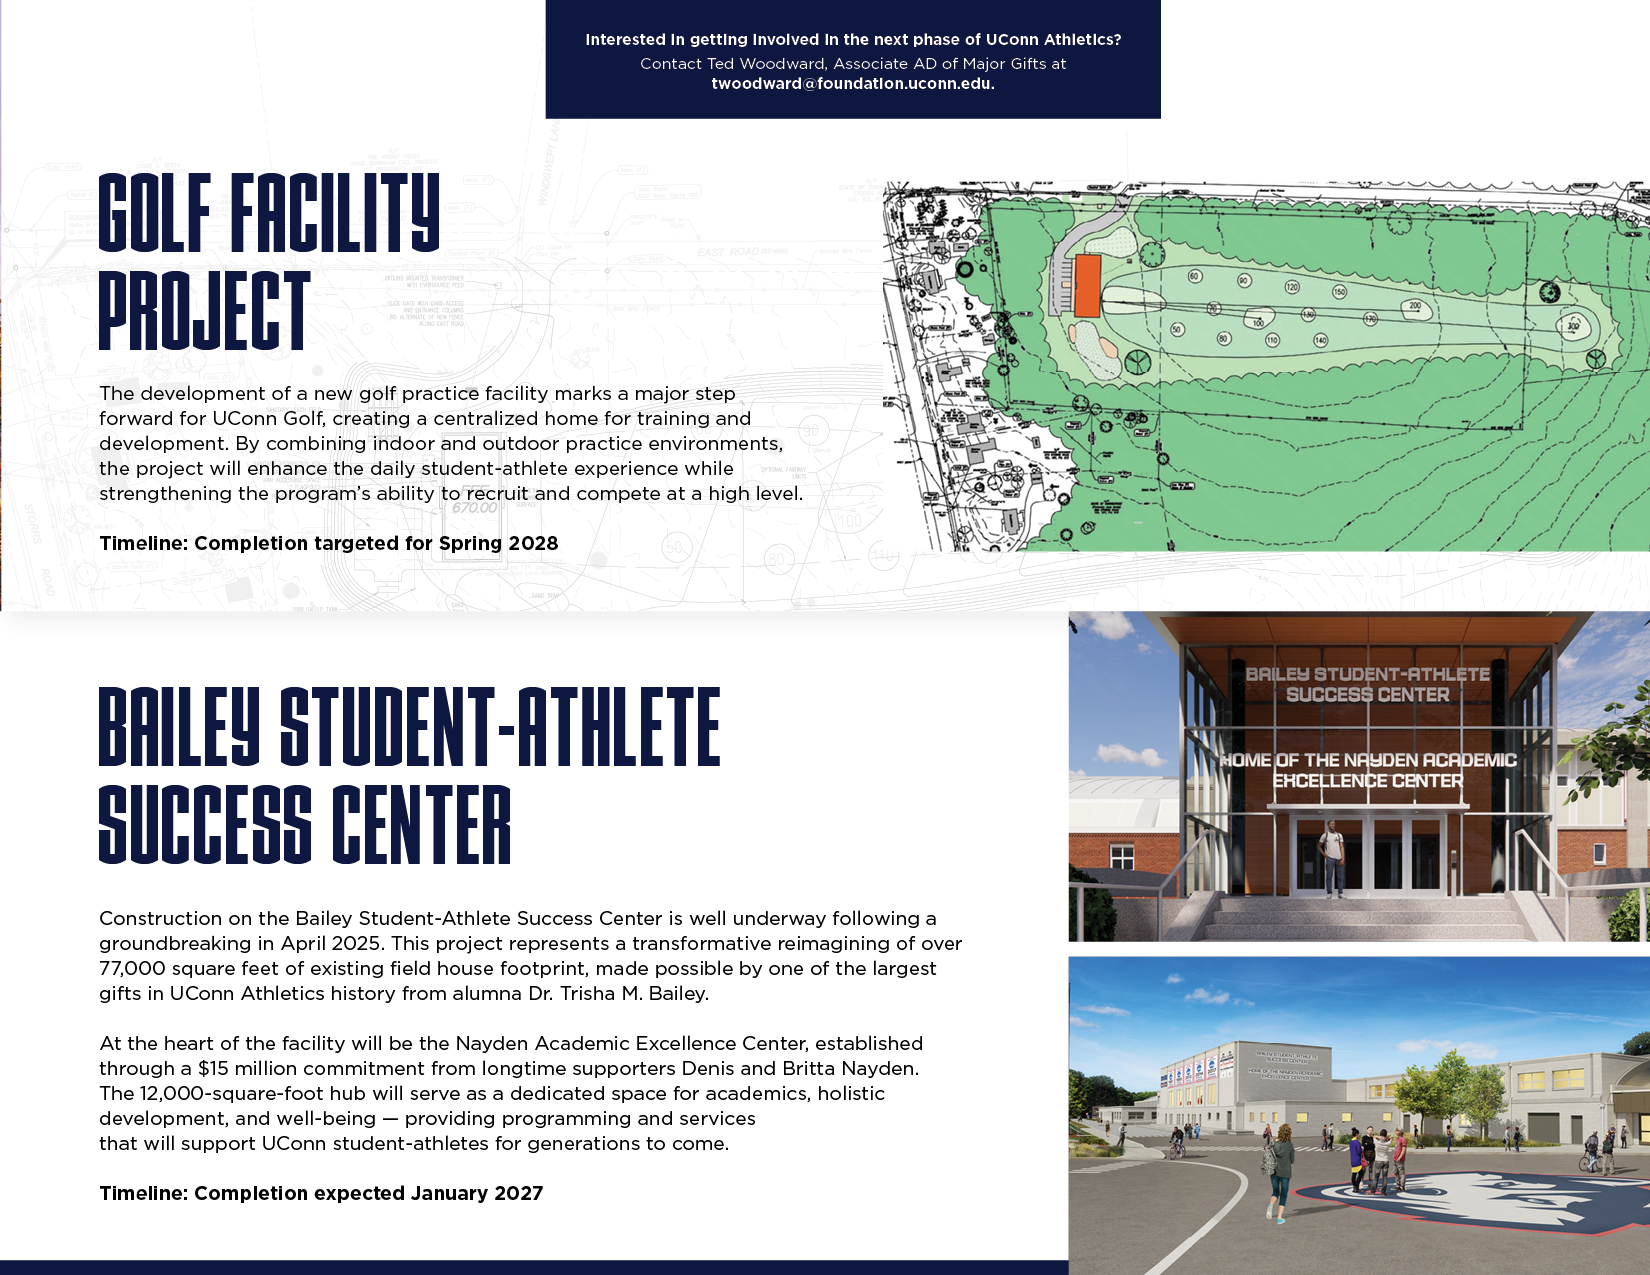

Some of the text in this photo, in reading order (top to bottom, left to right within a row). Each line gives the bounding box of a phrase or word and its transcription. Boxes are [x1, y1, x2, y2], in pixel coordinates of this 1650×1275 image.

[697, 247, 760, 257] EAST ROAD
[1190, 272, 1199, 280] 60
[1240, 277, 1249, 285] 90
[1287, 283, 1298, 291] 120
[1334, 288, 1346, 296] 150
[1410, 301, 1422, 309] 200
[1253, 320, 1264, 328] 100
[1172, 326, 1182, 334] 50
[1219, 335, 1228, 343] 80
[1267, 337, 1278, 345] 110
[1316, 337, 1327, 345] 140
[452, 501, 498, 514] 670.00
[23, 503, 56, 597] STORRS ROAD
[1245, 667, 1491, 682] BAILEY STUDENT-ATHLETE
[1286, 687, 1451, 703] SUCCESS CENTER
[1219, 752, 1518, 768] HOME OF THE NAYDEN ACADEMIC
[1272, 773, 1465, 789] EXCELLENCE CENTER
